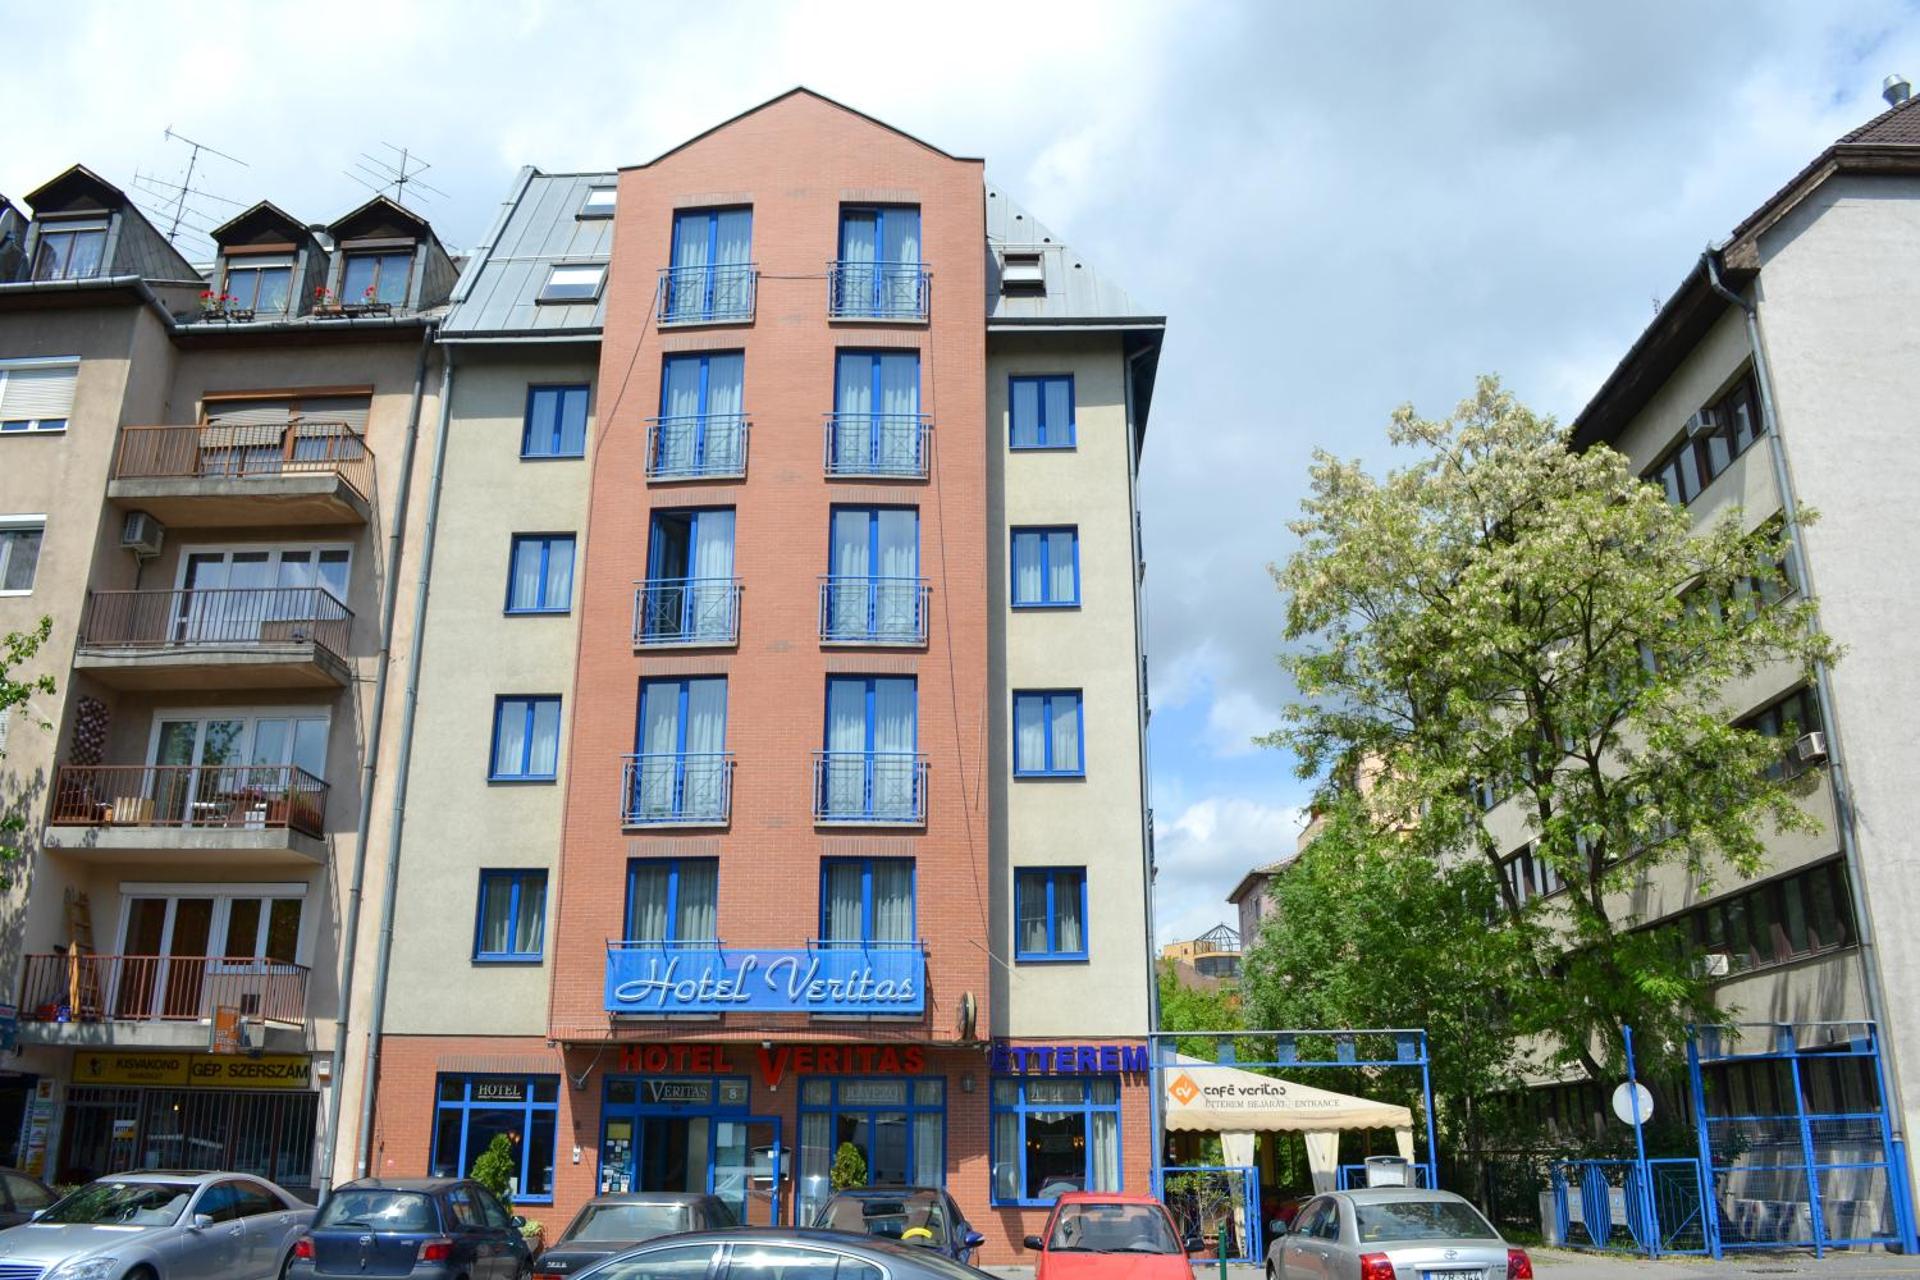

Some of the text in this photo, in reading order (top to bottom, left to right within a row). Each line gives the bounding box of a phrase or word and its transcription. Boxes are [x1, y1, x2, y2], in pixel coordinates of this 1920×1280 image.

[615, 954, 916, 1007] Hotel Veritas
[619, 1045, 926, 1087] HOTEL VERITAS
[478, 1084, 521, 1096] HOTEL
[647, 1079, 708, 1102] VERITAS
[728, 1087, 737, 1099] 8
[1238, 1082, 1287, 1096] veritas
[1295, 1098, 1340, 1108] ENTRANCE
